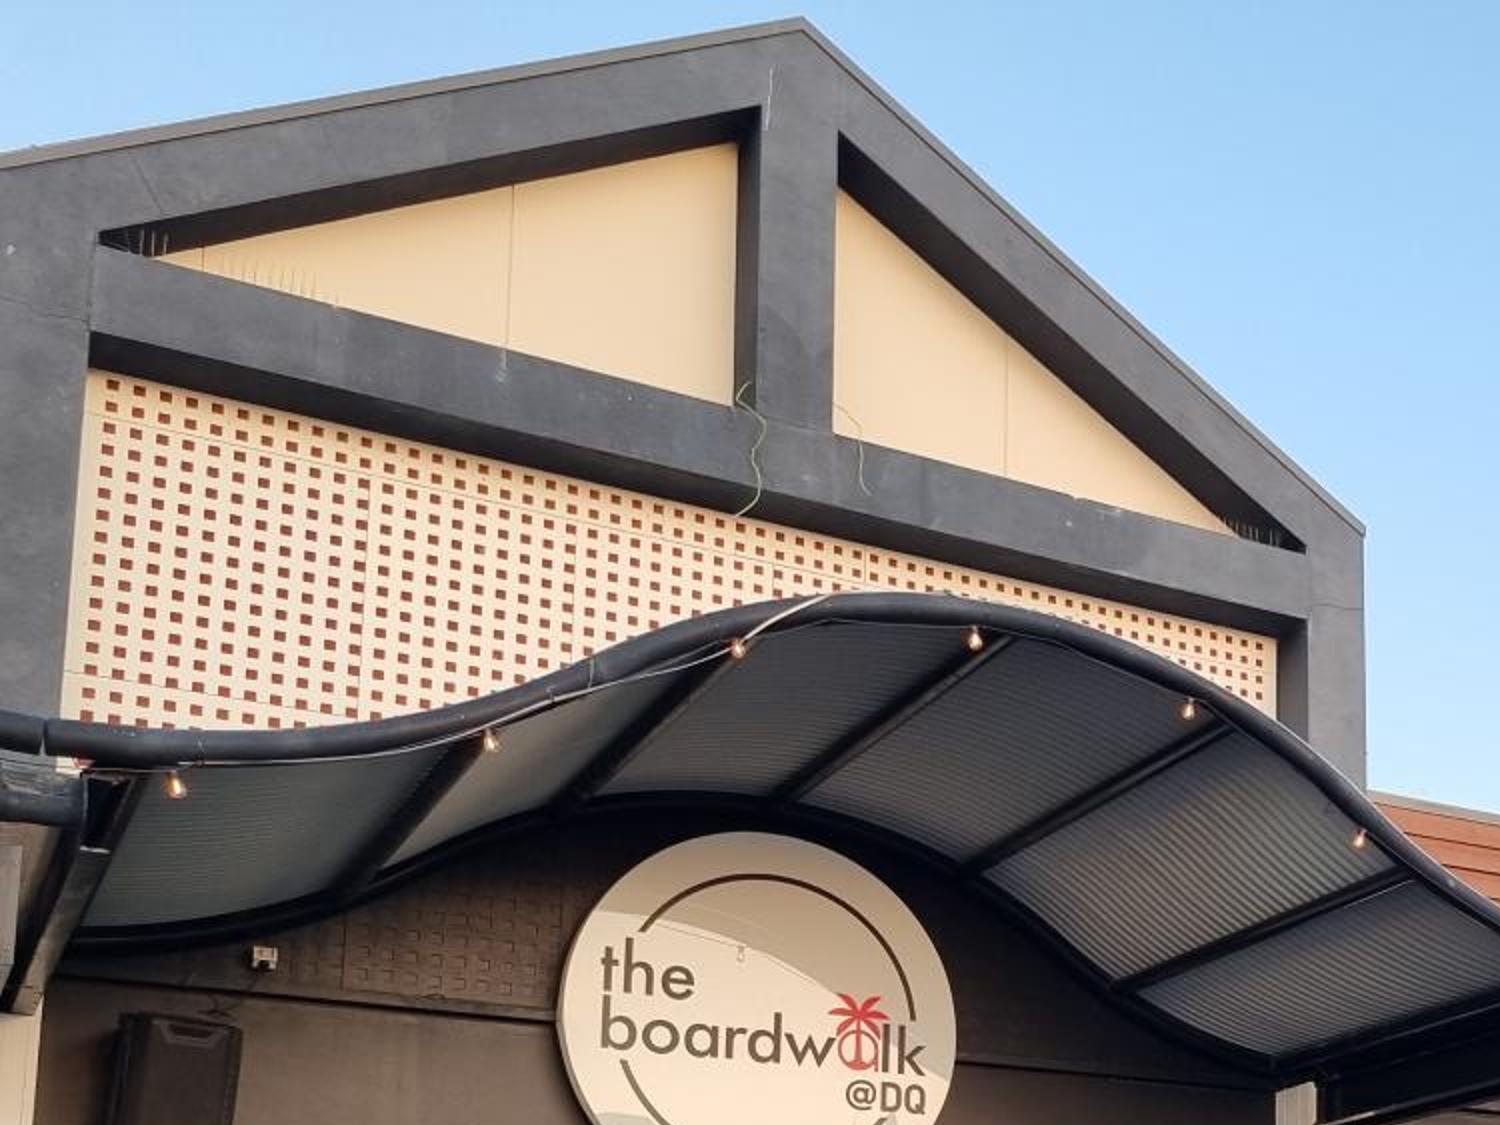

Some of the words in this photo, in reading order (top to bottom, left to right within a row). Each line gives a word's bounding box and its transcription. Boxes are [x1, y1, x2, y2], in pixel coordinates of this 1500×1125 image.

[601, 937, 695, 1000] the
[600, 993, 926, 1077] boardwalk
[845, 1079, 926, 1115] @DQ
